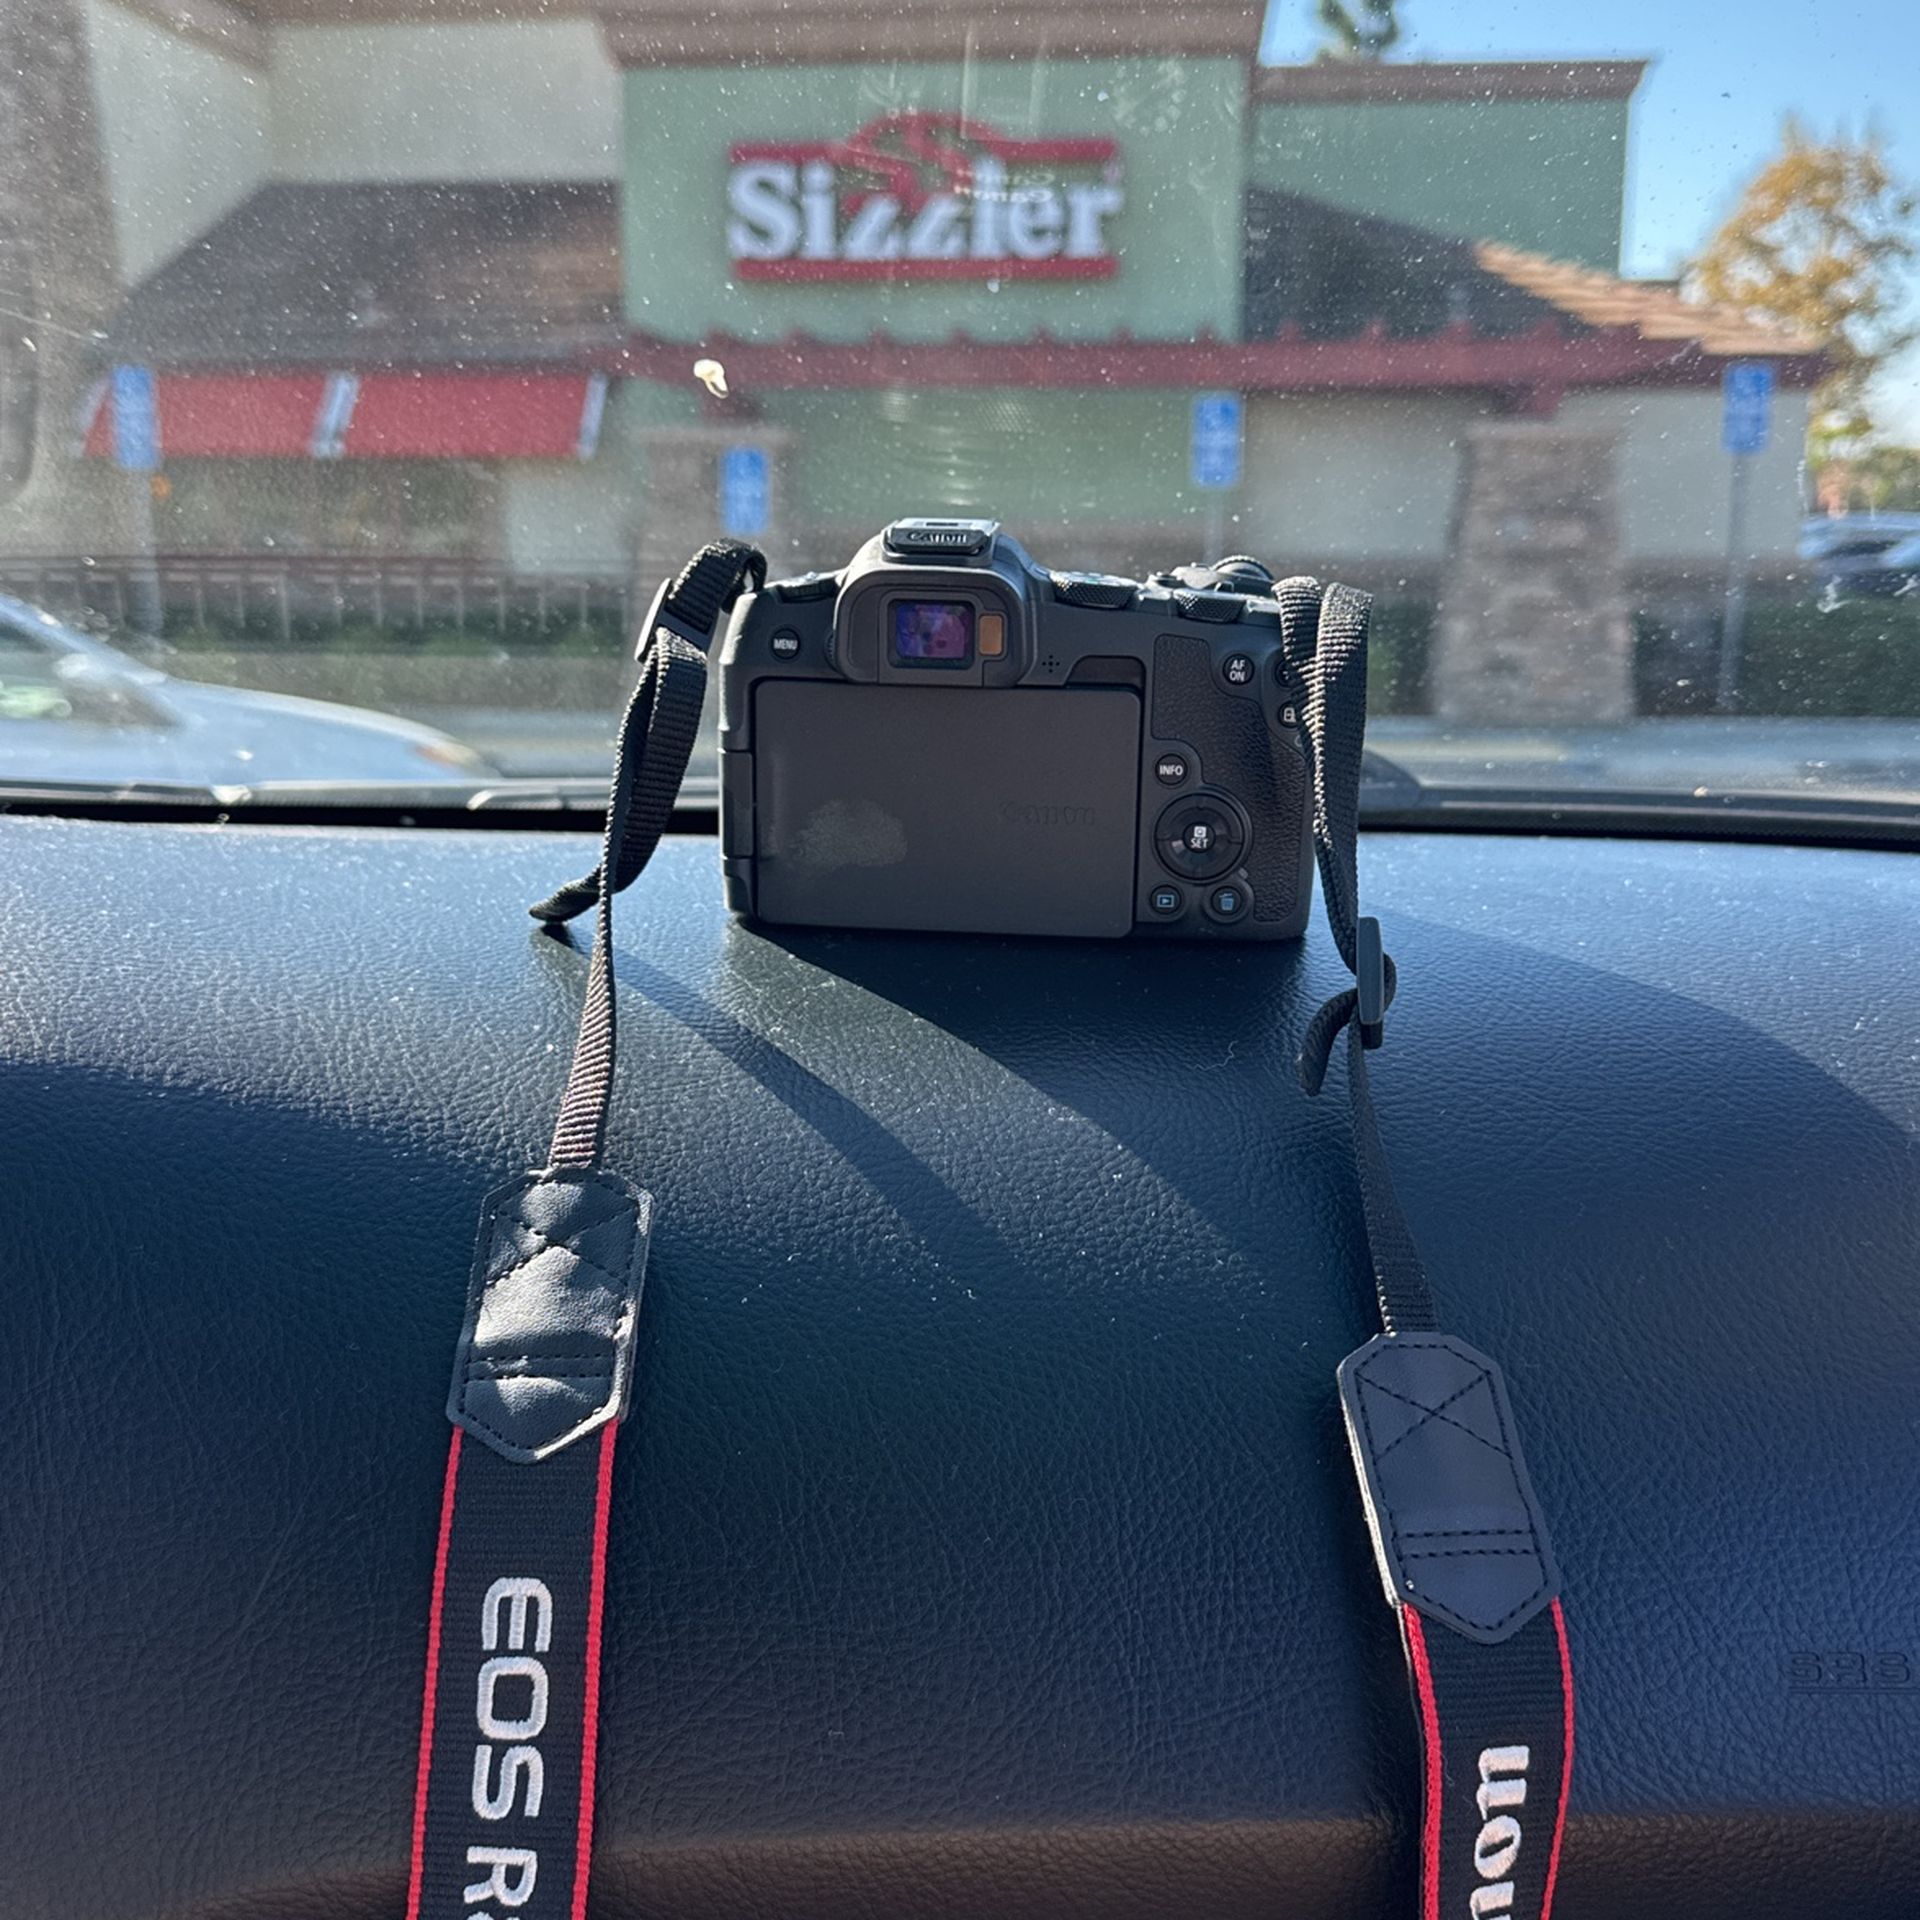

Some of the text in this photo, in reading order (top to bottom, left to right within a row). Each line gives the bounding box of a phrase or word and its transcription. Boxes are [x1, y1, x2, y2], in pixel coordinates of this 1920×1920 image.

[728, 156, 1122, 260] Sizzler
[908, 530, 968, 544] Canon
[773, 638, 798, 650] MENU
[1230, 659, 1246, 670] AF
[1229, 670, 1246, 682] ON
[1159, 764, 1184, 776] INFO
[1190, 837, 1208, 849] SET
[463, 1577, 553, 1920] EOS R
